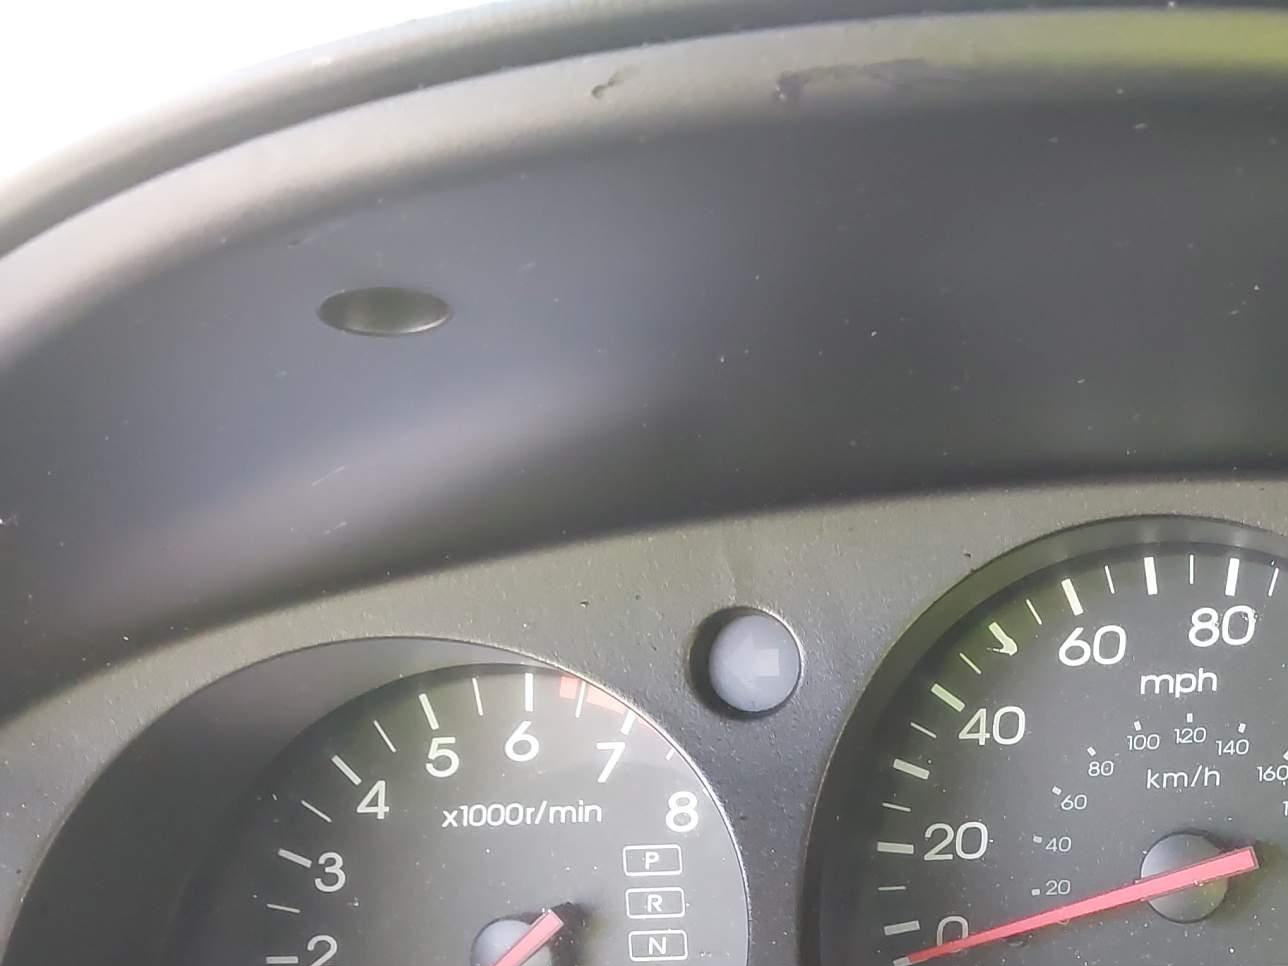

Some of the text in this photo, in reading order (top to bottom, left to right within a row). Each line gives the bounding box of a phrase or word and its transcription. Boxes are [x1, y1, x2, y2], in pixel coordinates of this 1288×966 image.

[1189, 606, 1256, 647] 80
[1059, 625, 1126, 666] 60
[1141, 668, 1217, 698] mph
[959, 706, 1026, 746] 40
[1175, 728, 1206, 743] 120
[505, 721, 539, 761] 6
[1127, 734, 1159, 750] 100
[1216, 739, 1249, 755] 140
[426, 737, 459, 777] 5
[597, 742, 625, 782] 7
[1089, 761, 1114, 776] 80
[1147, 765, 1220, 788] km/h
[1257, 765, 1288, 781] 160
[357, 781, 389, 819] 4
[666, 791, 699, 832] 8
[1061, 795, 1087, 810] 60
[924, 822, 988, 860] 20
[1046, 837, 1071, 852] 40
[315, 852, 345, 892] 3
[645, 852, 659, 869] P
[1046, 880, 1070, 895] 20
[648, 894, 662, 912] R
[649, 937, 666, 954] N
